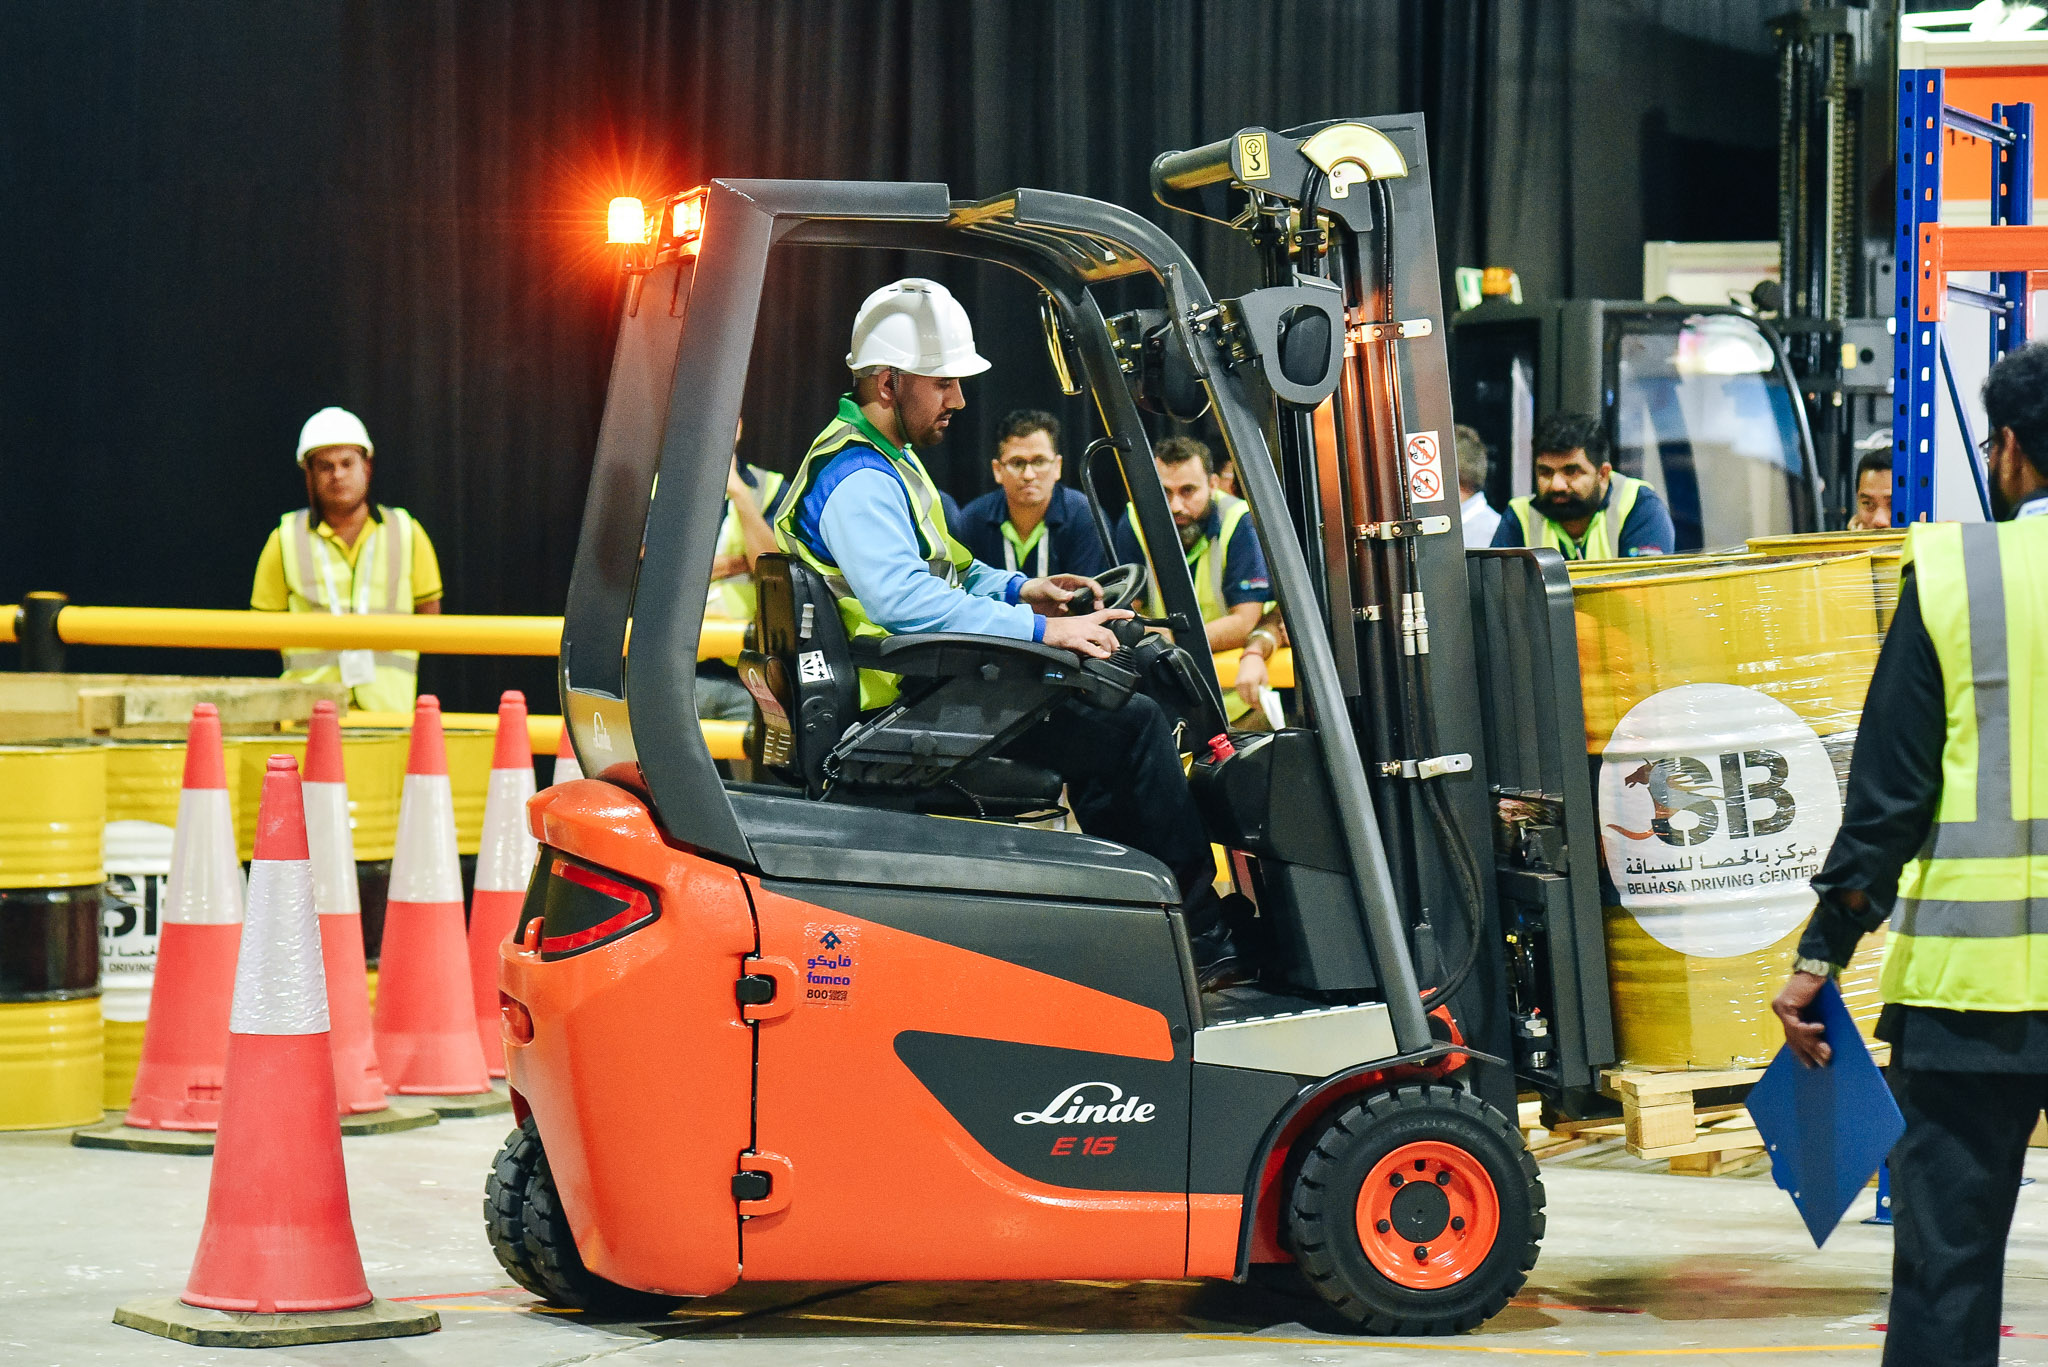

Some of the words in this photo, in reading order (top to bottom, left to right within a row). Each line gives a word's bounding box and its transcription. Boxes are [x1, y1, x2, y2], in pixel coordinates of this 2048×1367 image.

[1698, 847, 1770, 870] بالحصا
[1775, 842, 1818, 866] مركز
[1625, 854, 1693, 879] للسياقة
[1627, 878, 1687, 896] BELHASA
[1690, 872, 1755, 892] DRIVING
[1760, 862, 1820, 885] CENTER
[807, 954, 852, 969] فامكو
[806, 971, 851, 985] famco
[806, 989, 829, 1000] 800
[1013, 1081, 1156, 1125] Linde
[1050, 1136, 1078, 1156] E
[1082, 1136, 1119, 1156] 16
